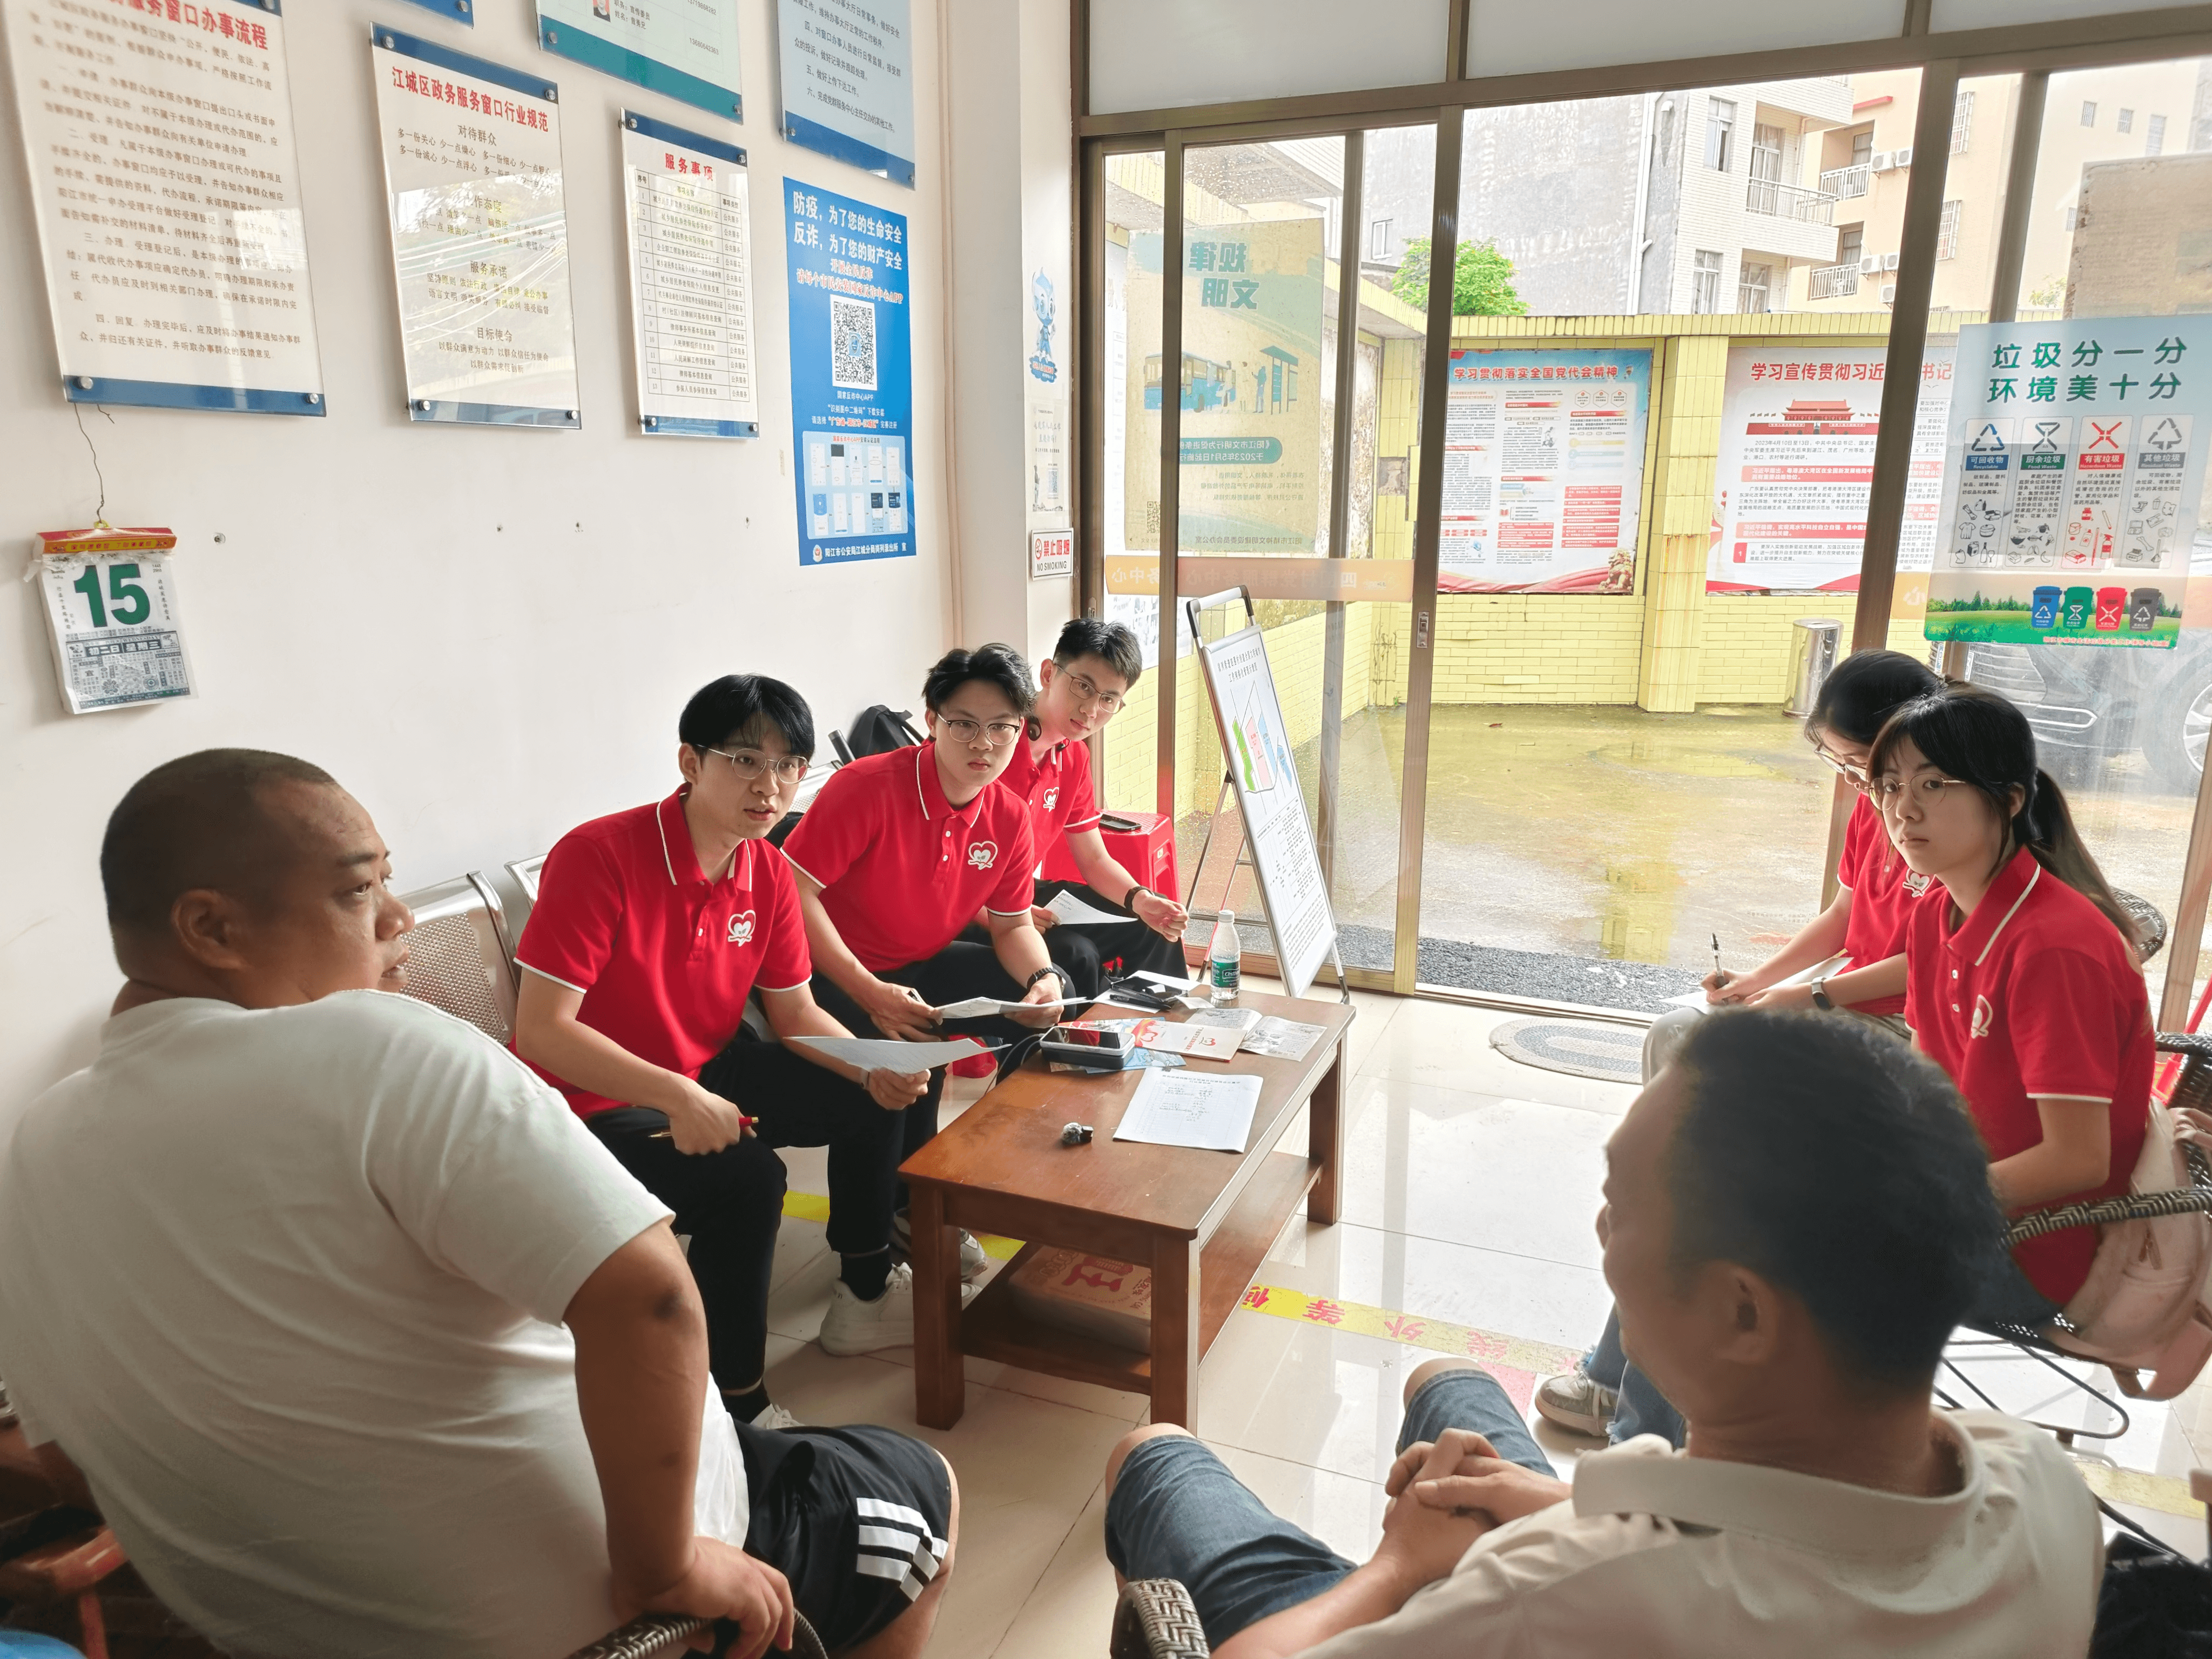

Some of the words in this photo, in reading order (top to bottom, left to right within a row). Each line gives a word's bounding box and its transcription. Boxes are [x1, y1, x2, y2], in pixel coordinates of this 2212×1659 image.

[392, 66, 549, 132] 江城区政务服务窗口行业规范
[457, 124, 497, 147] 对待群众
[665, 153, 713, 181] 服务事项
[793, 191, 902, 244] 防疫，为了您的生命安全
[794, 221, 902, 270] 反诈，为了您的财产安全
[470, 260, 508, 279] 服务承诺
[477, 327, 513, 343] 目标使命
[439, 341, 494, 356] 以群众满意为动力
[498, 348, 549, 362] 以群众信任为使命
[1991, 336, 2188, 369] 垃圾分一分
[1454, 366, 1618, 379] 学习贯彻落实全国党代会精神
[1922, 362, 1952, 381] 书记
[1986, 371, 2182, 404] 环境美十分
[1971, 456, 2004, 464] 可回收物
[2026, 455, 2061, 464] 厨余垃圾
[2085, 455, 2120, 463] 有害垃圾
[2144, 454, 2180, 462] 其他垃圾
[1043, 539, 1070, 557] 禁止吸烟
[1037, 563, 1043, 572] NO
[1044, 561, 1067, 571] SMOKING
[73, 563, 150, 628] 15
[125, 641, 160, 652] 星期三
